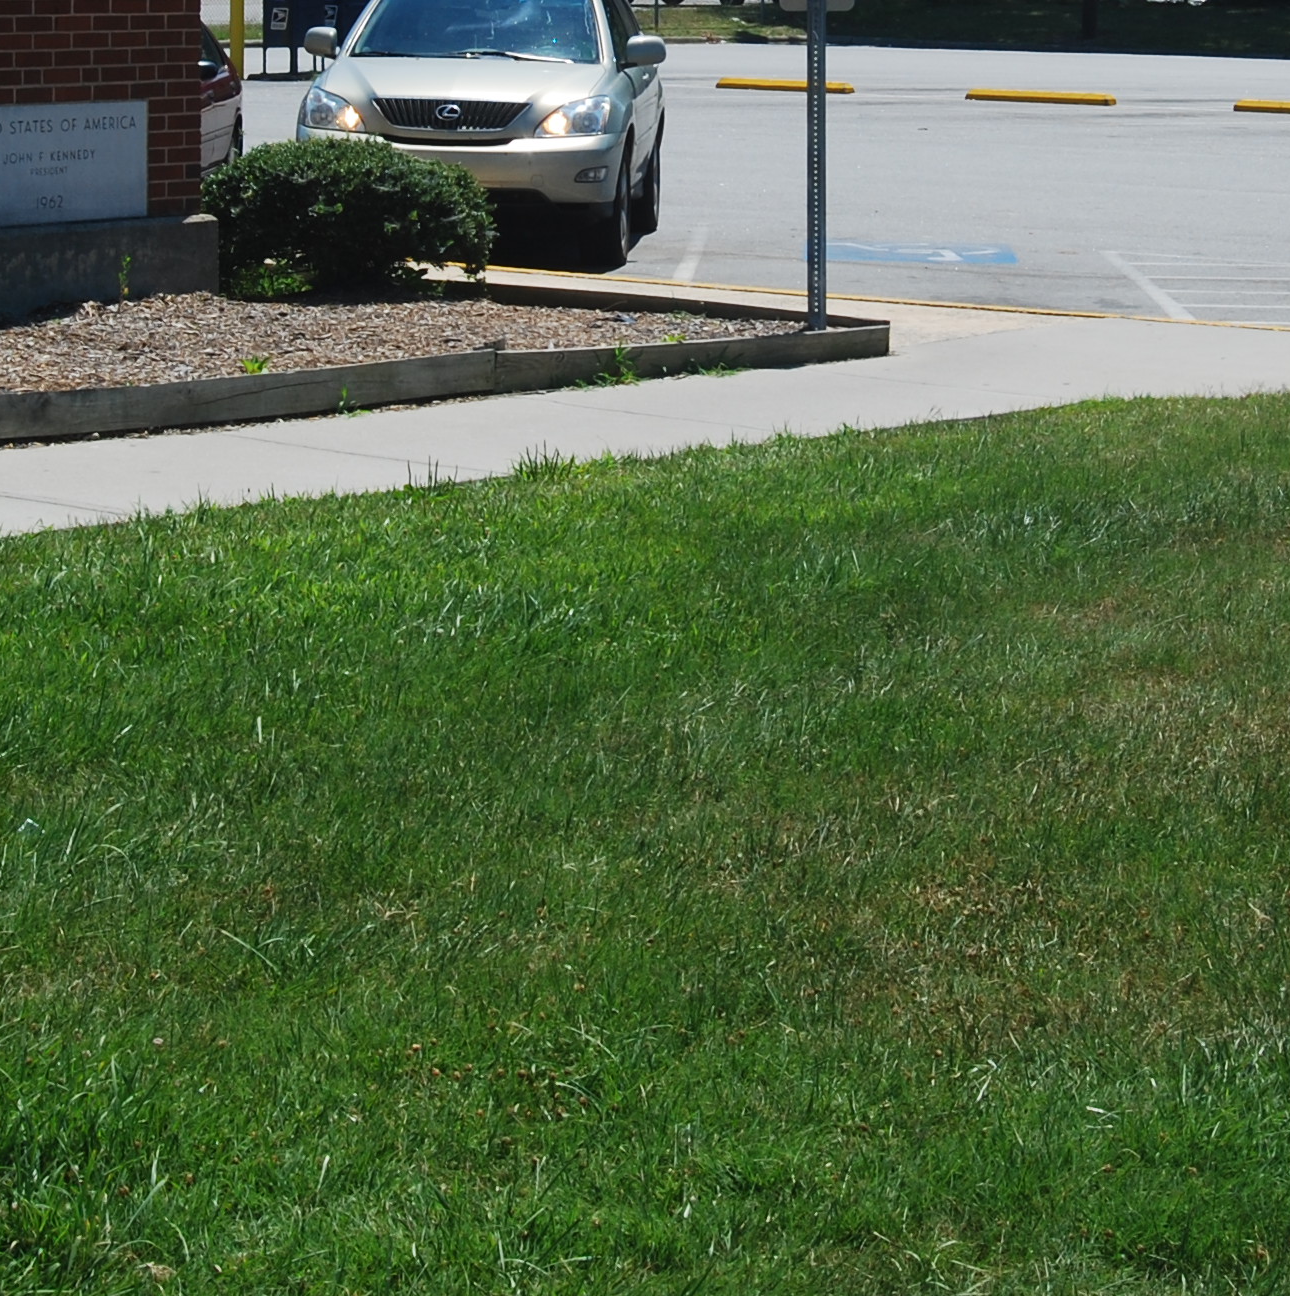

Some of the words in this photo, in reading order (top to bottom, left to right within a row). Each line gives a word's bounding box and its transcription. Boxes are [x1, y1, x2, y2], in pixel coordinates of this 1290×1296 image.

[10, 119, 53, 135] STATES
[61, 118, 77, 133] OF
[83, 115, 137, 131] AMERICA
[3, 152, 33, 165] JOHN
[50, 149, 96, 162] KENNEDY
[30, 166, 68, 176] PRESIDENT
[36, 195, 64, 210] 1962
